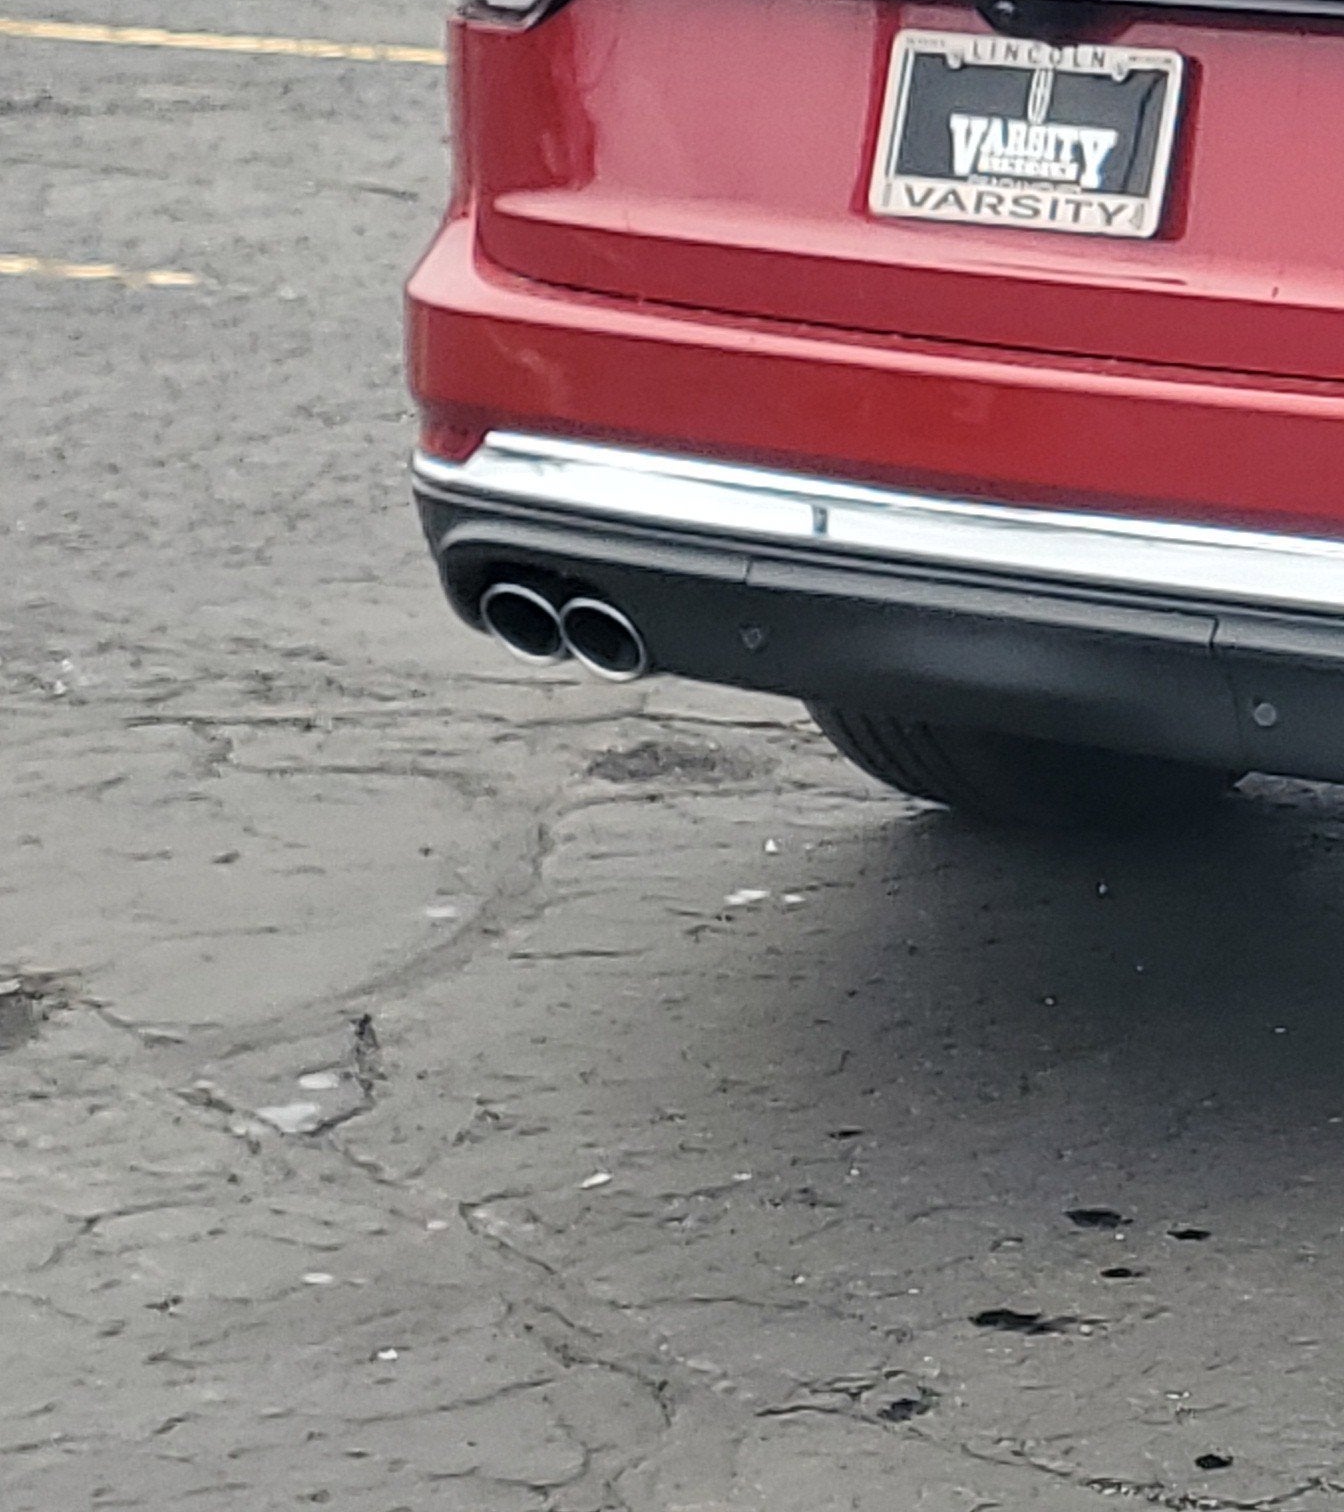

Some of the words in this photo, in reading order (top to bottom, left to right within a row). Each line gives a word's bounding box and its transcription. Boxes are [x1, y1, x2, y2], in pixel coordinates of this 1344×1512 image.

[973, 40, 1106, 68] LINCOLN
[949, 113, 1118, 190] VARSITY
[903, 183, 1128, 228] VARSITY
